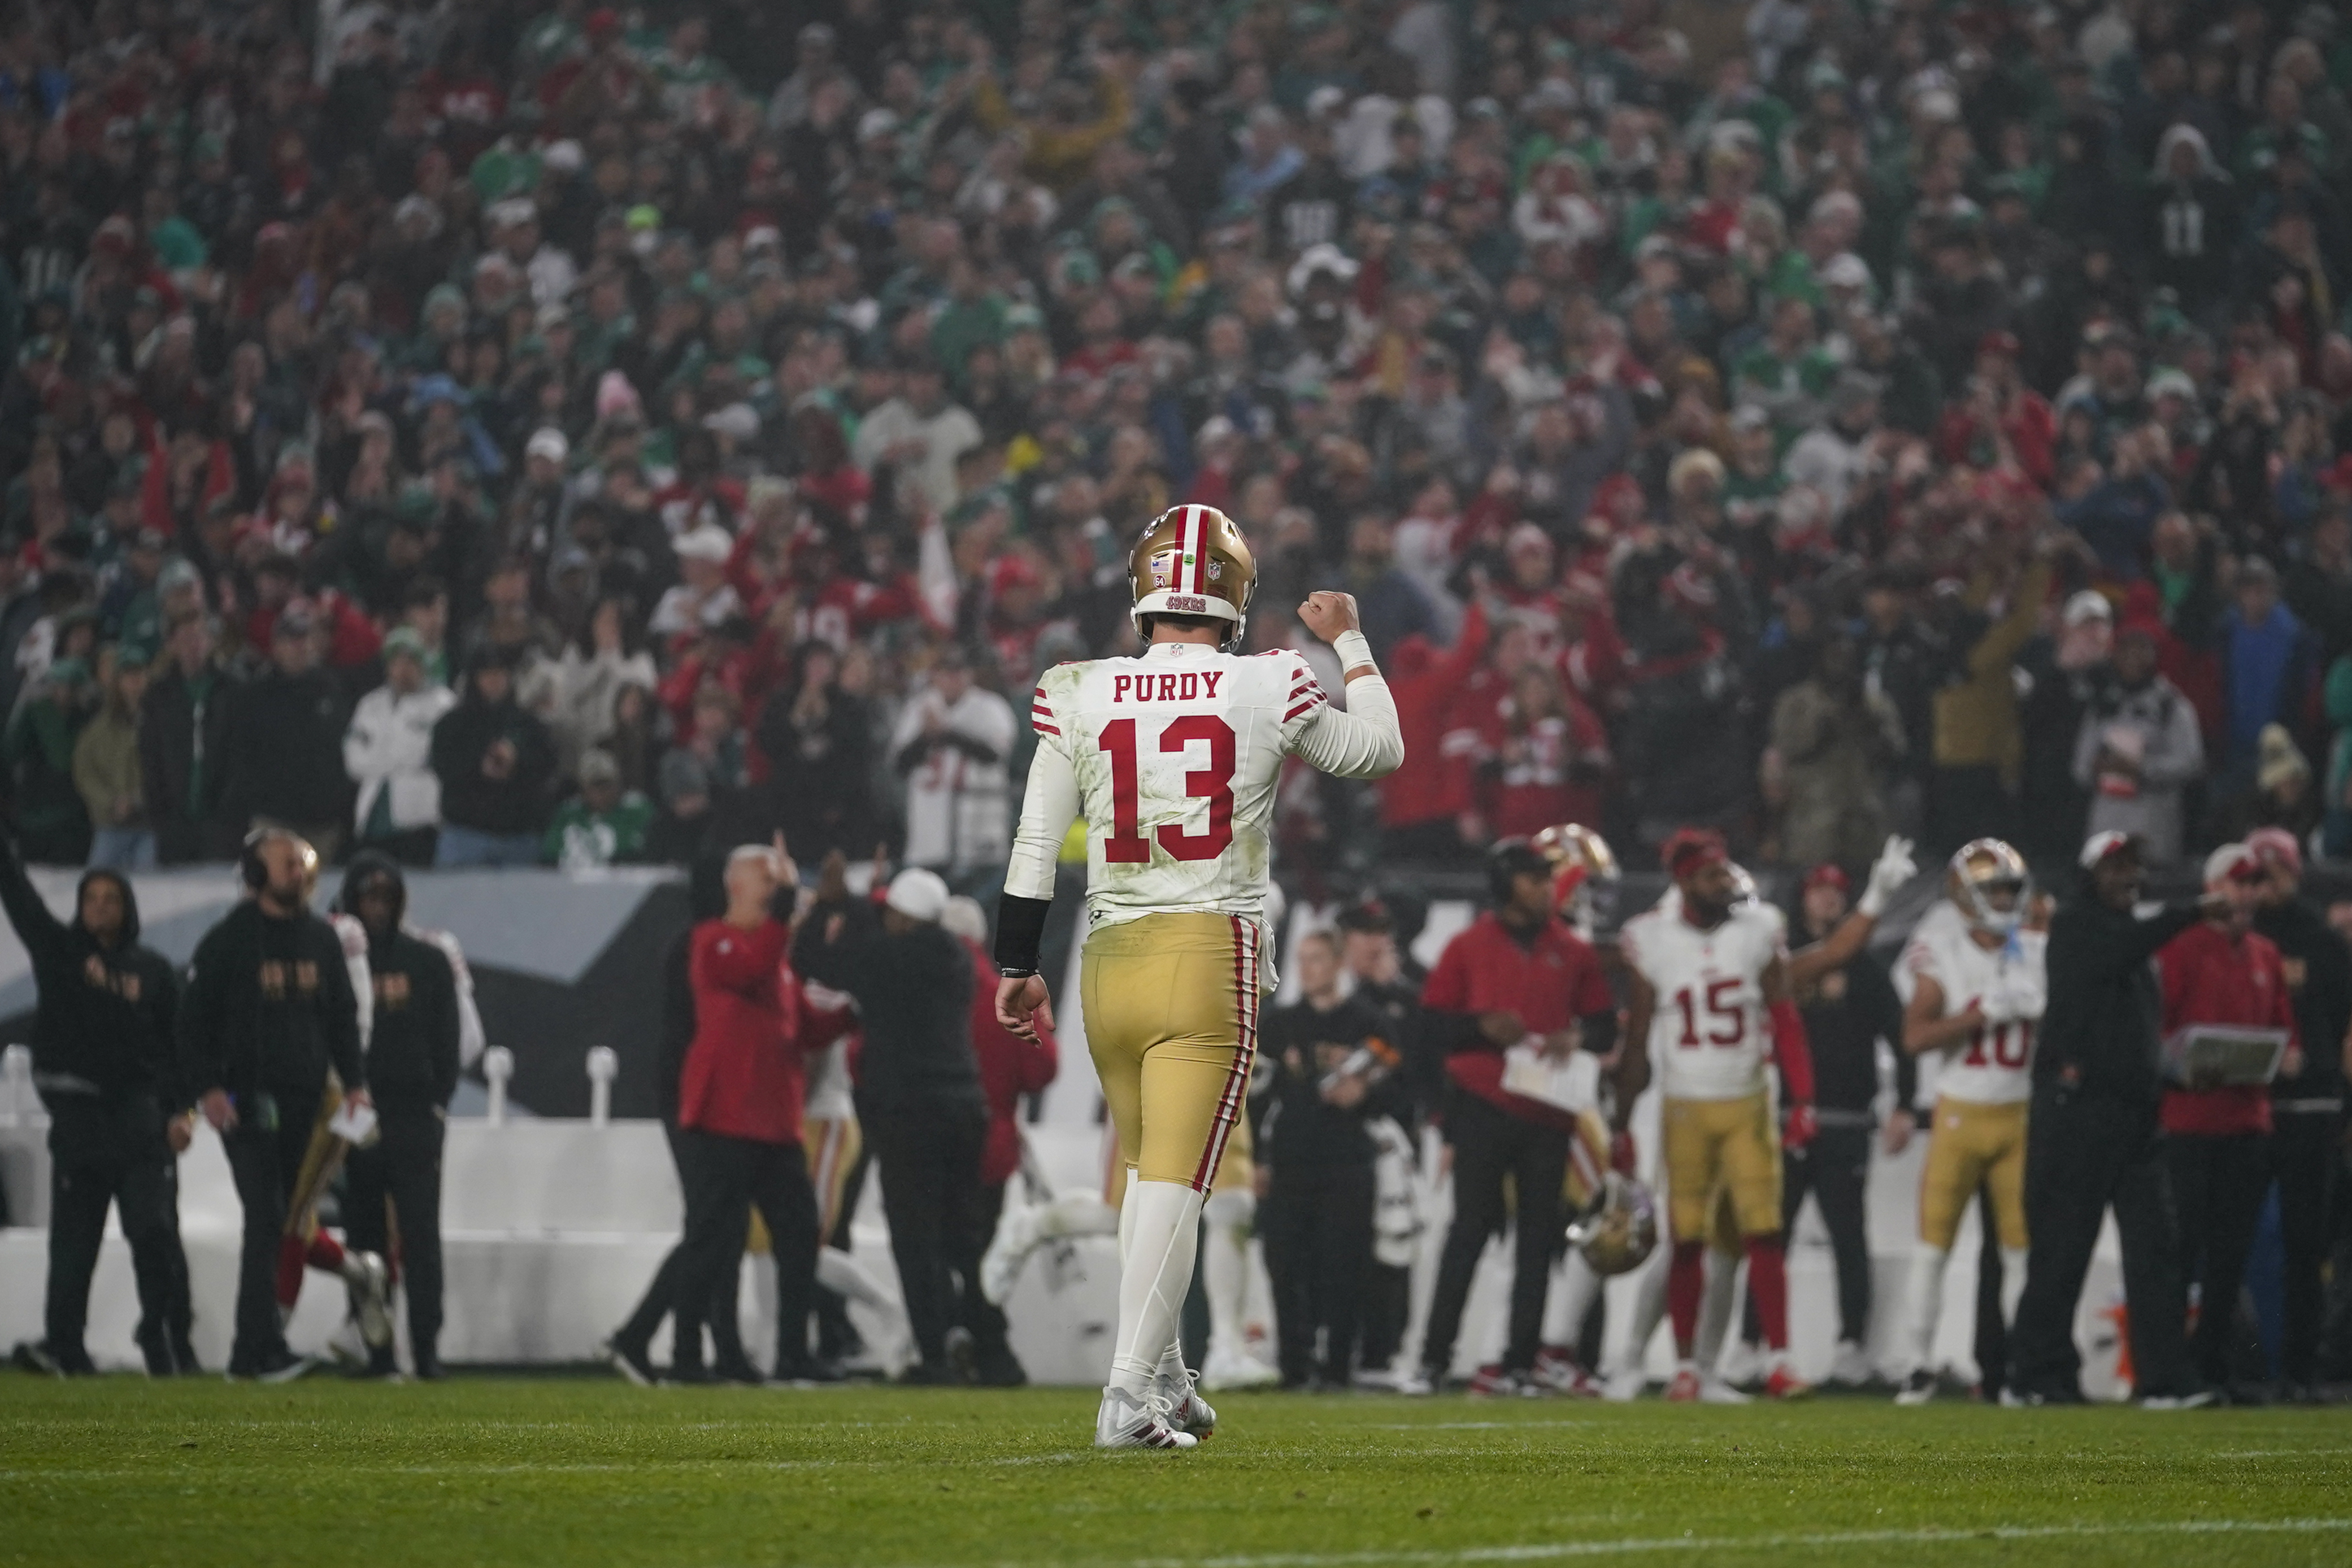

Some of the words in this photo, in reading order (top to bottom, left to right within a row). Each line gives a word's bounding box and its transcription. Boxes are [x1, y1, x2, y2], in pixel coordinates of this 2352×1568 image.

[1155, 577, 1164, 586] 64
[1166, 596, 1206, 612] 49ERS
[1114, 671, 1223, 702] PURDY
[1098, 715, 1236, 863] 13
[1676, 979, 1744, 1046] 15
[1965, 995, 2030, 1067] 10
